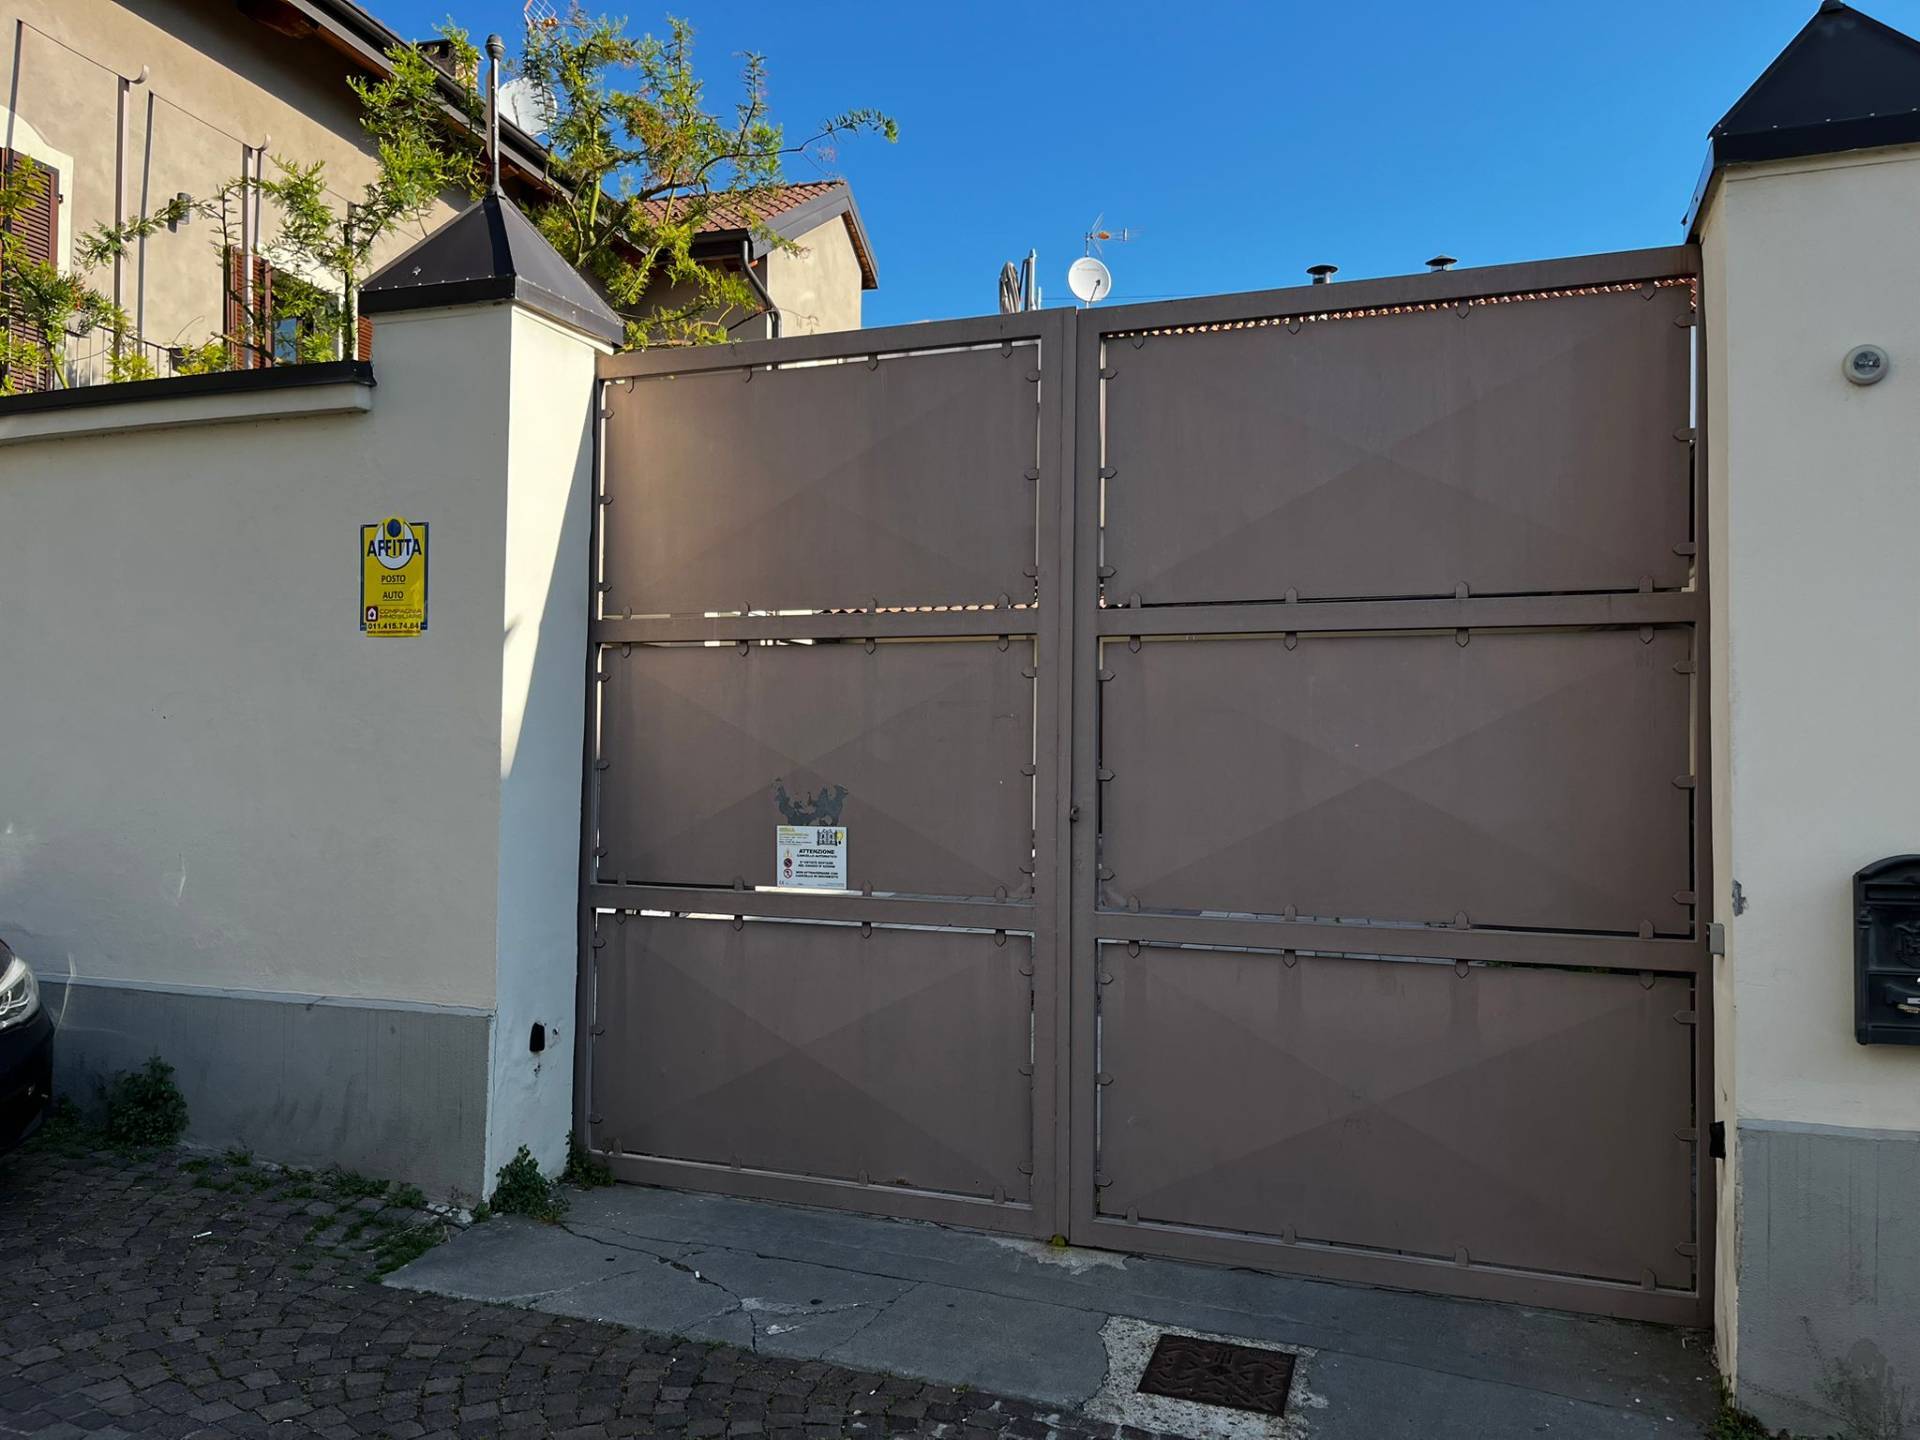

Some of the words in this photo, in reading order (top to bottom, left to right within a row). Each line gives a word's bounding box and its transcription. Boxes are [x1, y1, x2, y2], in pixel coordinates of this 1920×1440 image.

[367, 539, 422, 557] AFFITTA
[381, 575, 406, 583] POSTO
[383, 591, 404, 599] AUTO
